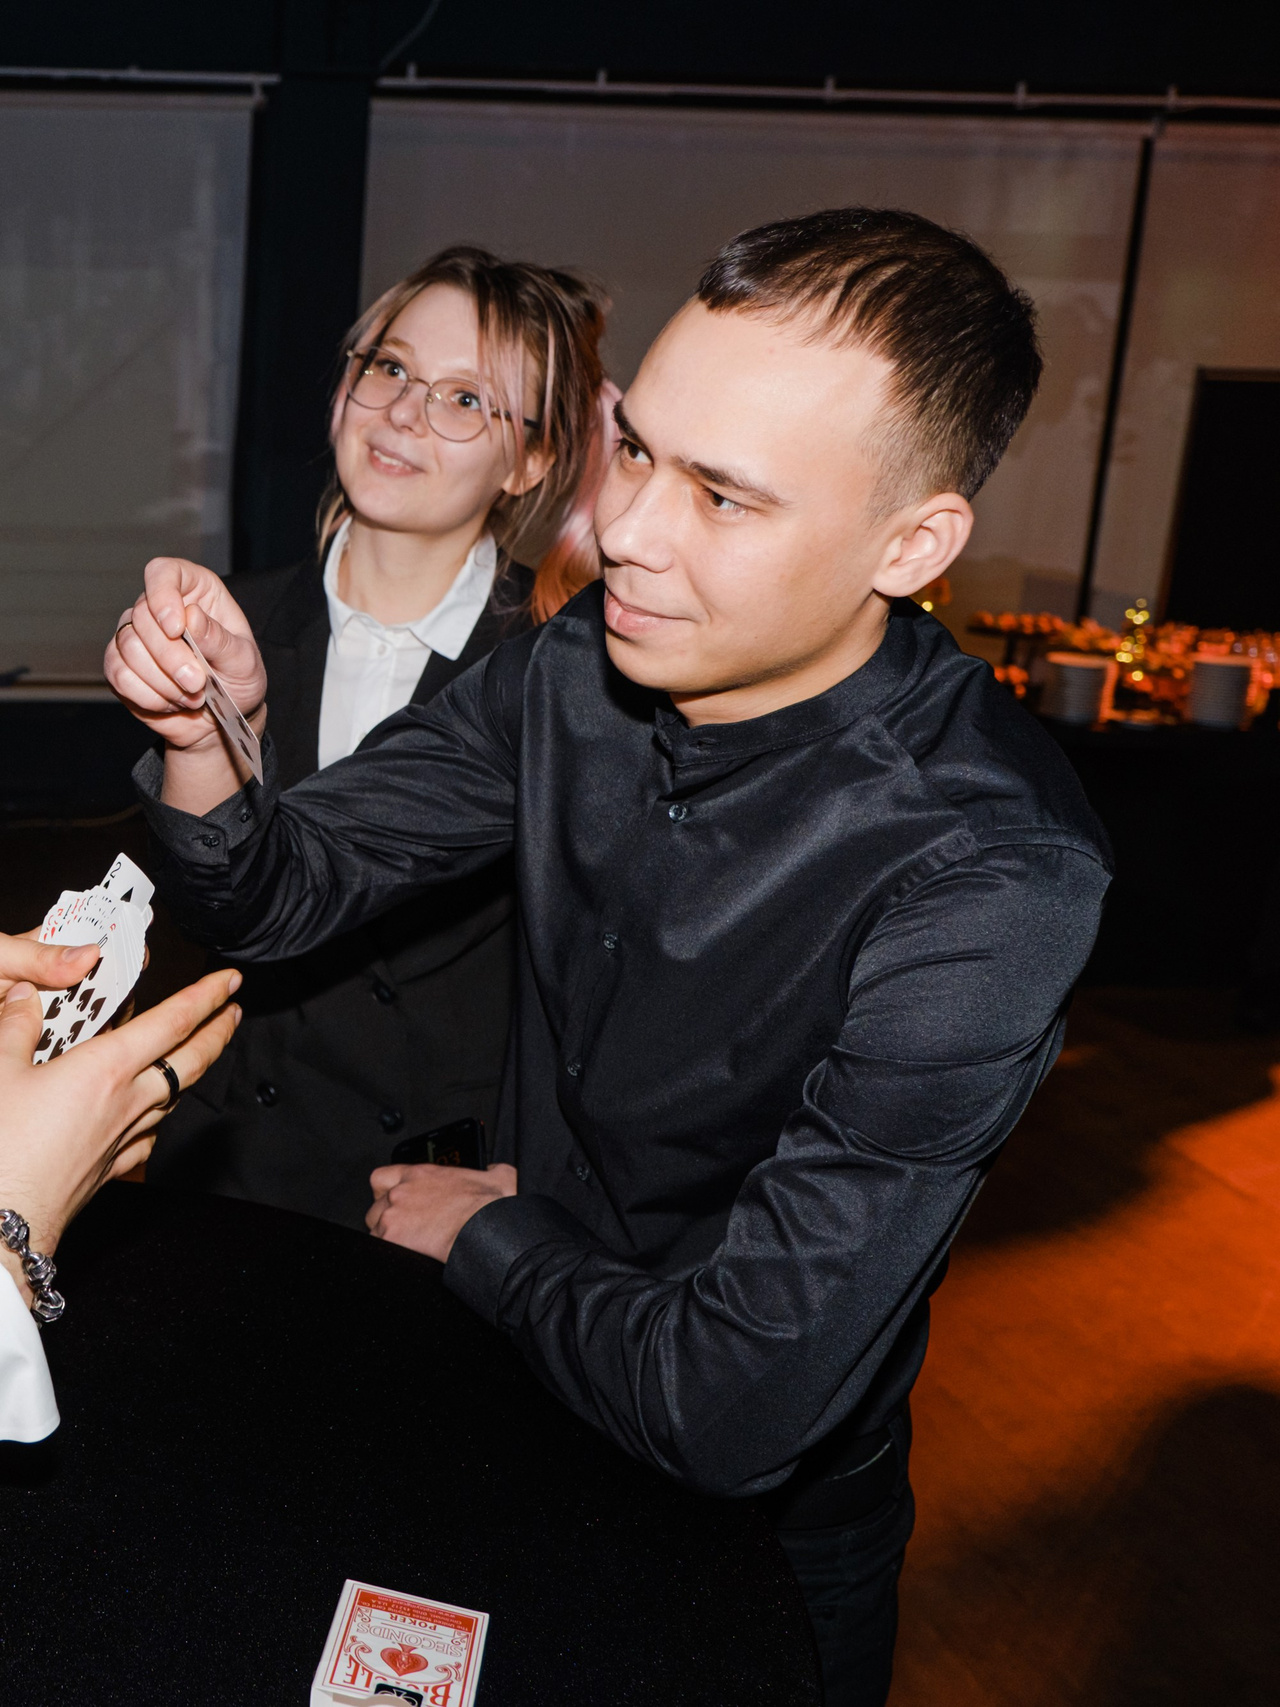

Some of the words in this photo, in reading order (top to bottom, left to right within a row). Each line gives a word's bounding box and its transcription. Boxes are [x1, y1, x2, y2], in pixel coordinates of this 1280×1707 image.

[110, 861, 122, 879] 2
[389, 1613, 437, 1631] POKER
[356, 1622, 463, 1657] SECONDS
